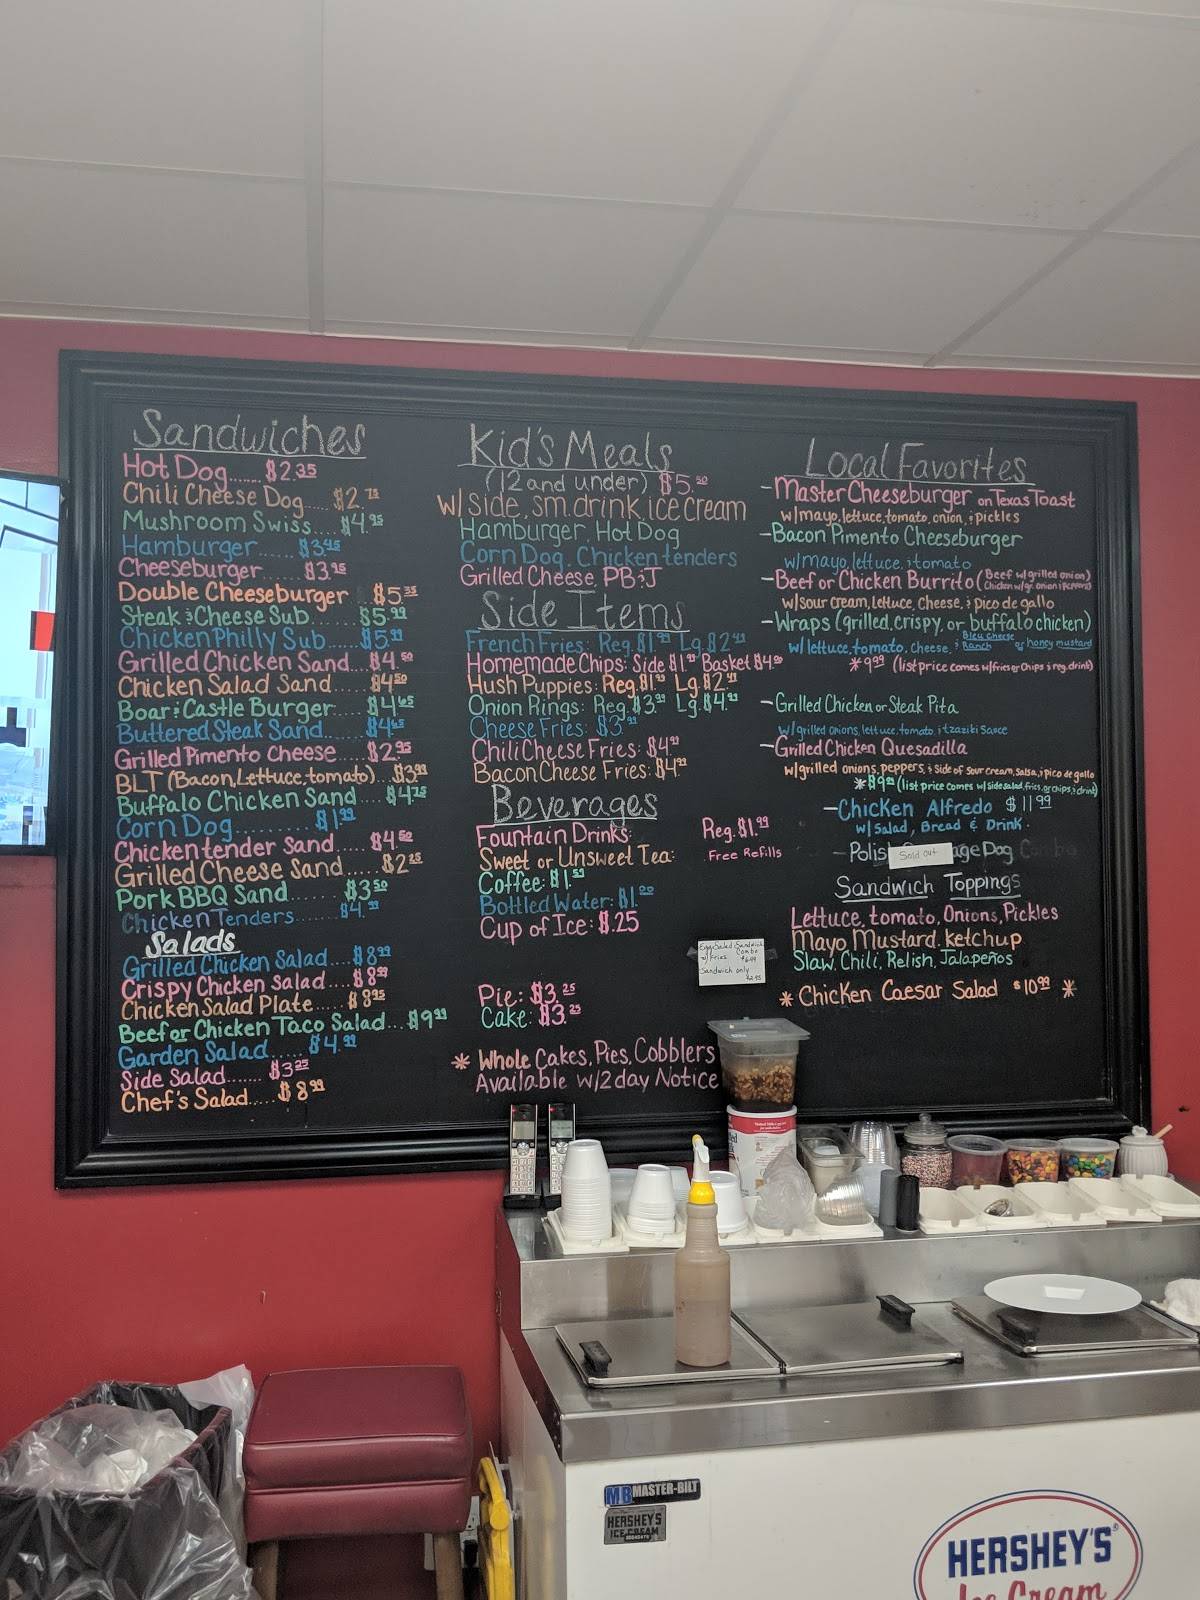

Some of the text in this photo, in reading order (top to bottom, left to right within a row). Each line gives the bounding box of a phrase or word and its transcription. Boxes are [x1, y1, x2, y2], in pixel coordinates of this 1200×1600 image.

[133, 408, 366, 456] Sandwiches
[469, 423, 673, 472] Kid's Meals
[122, 453, 168, 480] Hot
[805, 438, 1027, 483] Local Favorites
[527, 477, 565, 492] and
[122, 481, 304, 519] Chili Cheese Dog
[977, 489, 1076, 507] on Toast
[122, 510, 247, 532] Mushroom
[253, 511, 312, 535] Swiss
[975, 511, 1020, 525] pickles
[596, 518, 680, 550] Hot Dog
[771, 522, 1023, 556] Bacon Pimento Cheeseburger
[122, 535, 258, 562] Hamburger
[460, 539, 737, 568] Corn Chicken tenders
[118, 557, 264, 587] Cheeseburger
[460, 563, 524, 586] Grilled
[914, 554, 972, 570] tomato
[775, 569, 901, 591] Beef or Chicken
[118, 581, 349, 612] Double Cheeseburger
[974, 594, 1055, 615] pico gallo
[120, 605, 310, 627] Steak Cheese Sub
[481, 590, 558, 630] Side
[774, 611, 966, 633] Wraps or
[119, 627, 326, 650] Chicken Sub
[464, 630, 536, 654] French
[118, 650, 350, 674] Grilled Chicken Sand
[467, 651, 665, 676] Homemade Side
[118, 673, 333, 698] Chicken Salad Sand
[467, 673, 518, 696] Hush
[118, 698, 333, 724] Boar Castle Burger
[468, 695, 522, 717] Onion
[775, 691, 959, 715] Grilled Chicken or Steak Pita
[117, 719, 324, 745] Buttered Steak Sand
[469, 714, 537, 740] Cheese
[114, 744, 261, 770] Grilled Pimento
[472, 737, 585, 762] Chili Cheese
[774, 734, 969, 758] Grilled Chicken Quesadilla
[116, 771, 163, 795] BLT
[474, 761, 597, 784] Bacon Cheese
[117, 787, 357, 817] Buffalo Chicken Sand
[491, 783, 659, 828] Beverages
[926, 798, 993, 817] Alfredo
[116, 813, 233, 842] Corn Dog
[475, 824, 567, 848] Fountain
[921, 820, 961, 833] Bread
[283, 833, 335, 855] Sand
[708, 847, 782, 861] Free Refills
[114, 855, 344, 888] Grilled Cheese Sand
[479, 847, 554, 871] Sweet or
[116, 880, 289, 911] Pork BBQ Sand
[834, 871, 1021, 899] Sandwich Toppings
[479, 895, 550, 917] Bottled
[1003, 902, 1059, 923] Pickles
[145, 929, 236, 958] Salads
[480, 917, 522, 946] Cup
[529, 917, 549, 938] of
[123, 948, 328, 980] Grilled Chicken Salad
[940, 948, 1014, 967] Jalapeños
[121, 970, 326, 1002] Crispy Chicken Salad
[881, 978, 999, 1001] Caesar Salad
[201, 995, 314, 1016] Salad Plate
[119, 1011, 386, 1045] Beef Taco Salad
[118, 1039, 269, 1070] Garden Salad
[478, 1036, 715, 1071] Whole Cobblers
[120, 1065, 227, 1091] Side Salad
[476, 1066, 720, 1092] Available Notice
[194, 1087, 250, 1109] Salad
[632, 1480, 698, 1497] MASTER-BILT
[948, 1526, 1111, 1578] HERSHEY'S
